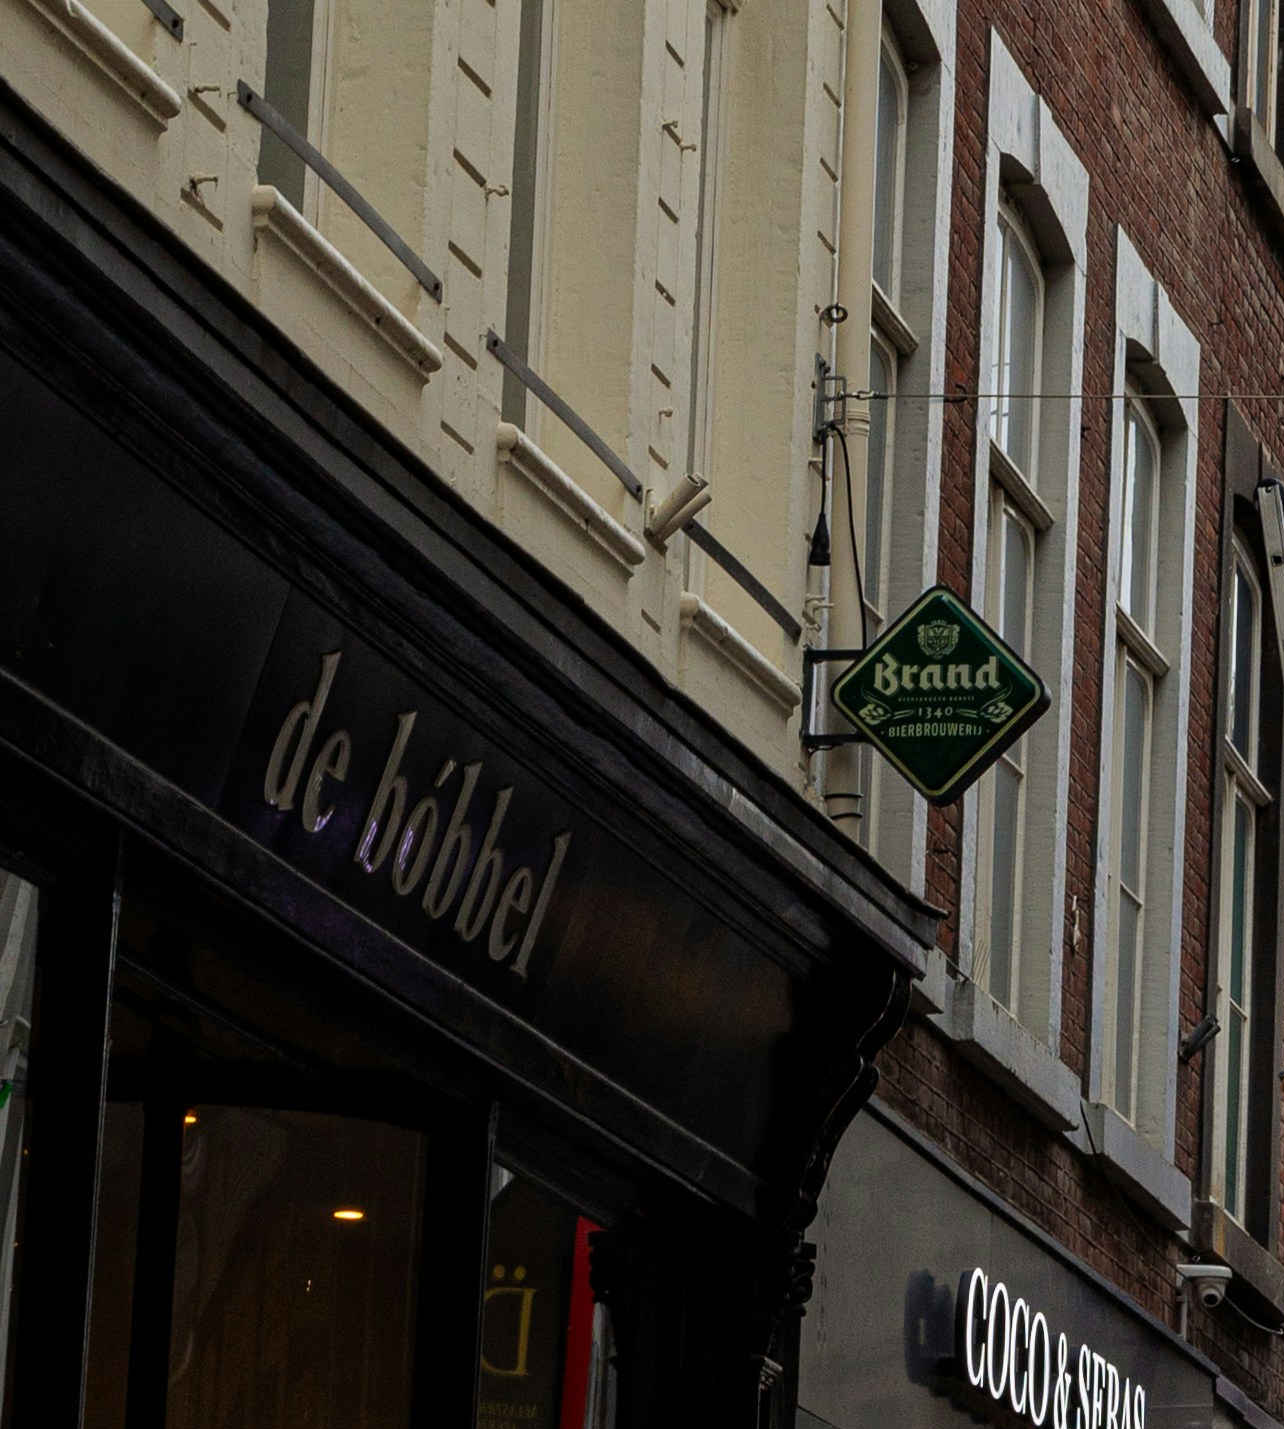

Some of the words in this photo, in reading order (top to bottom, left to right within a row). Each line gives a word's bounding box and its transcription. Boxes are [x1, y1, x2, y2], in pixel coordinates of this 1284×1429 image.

[874, 652, 1001, 697] Brand
[888, 722, 983, 738] BIERBROUWERIJ
[918, 706, 954, 720] 1340
[263, 651, 350, 833] de
[966, 1266, 1050, 1427] COCO
